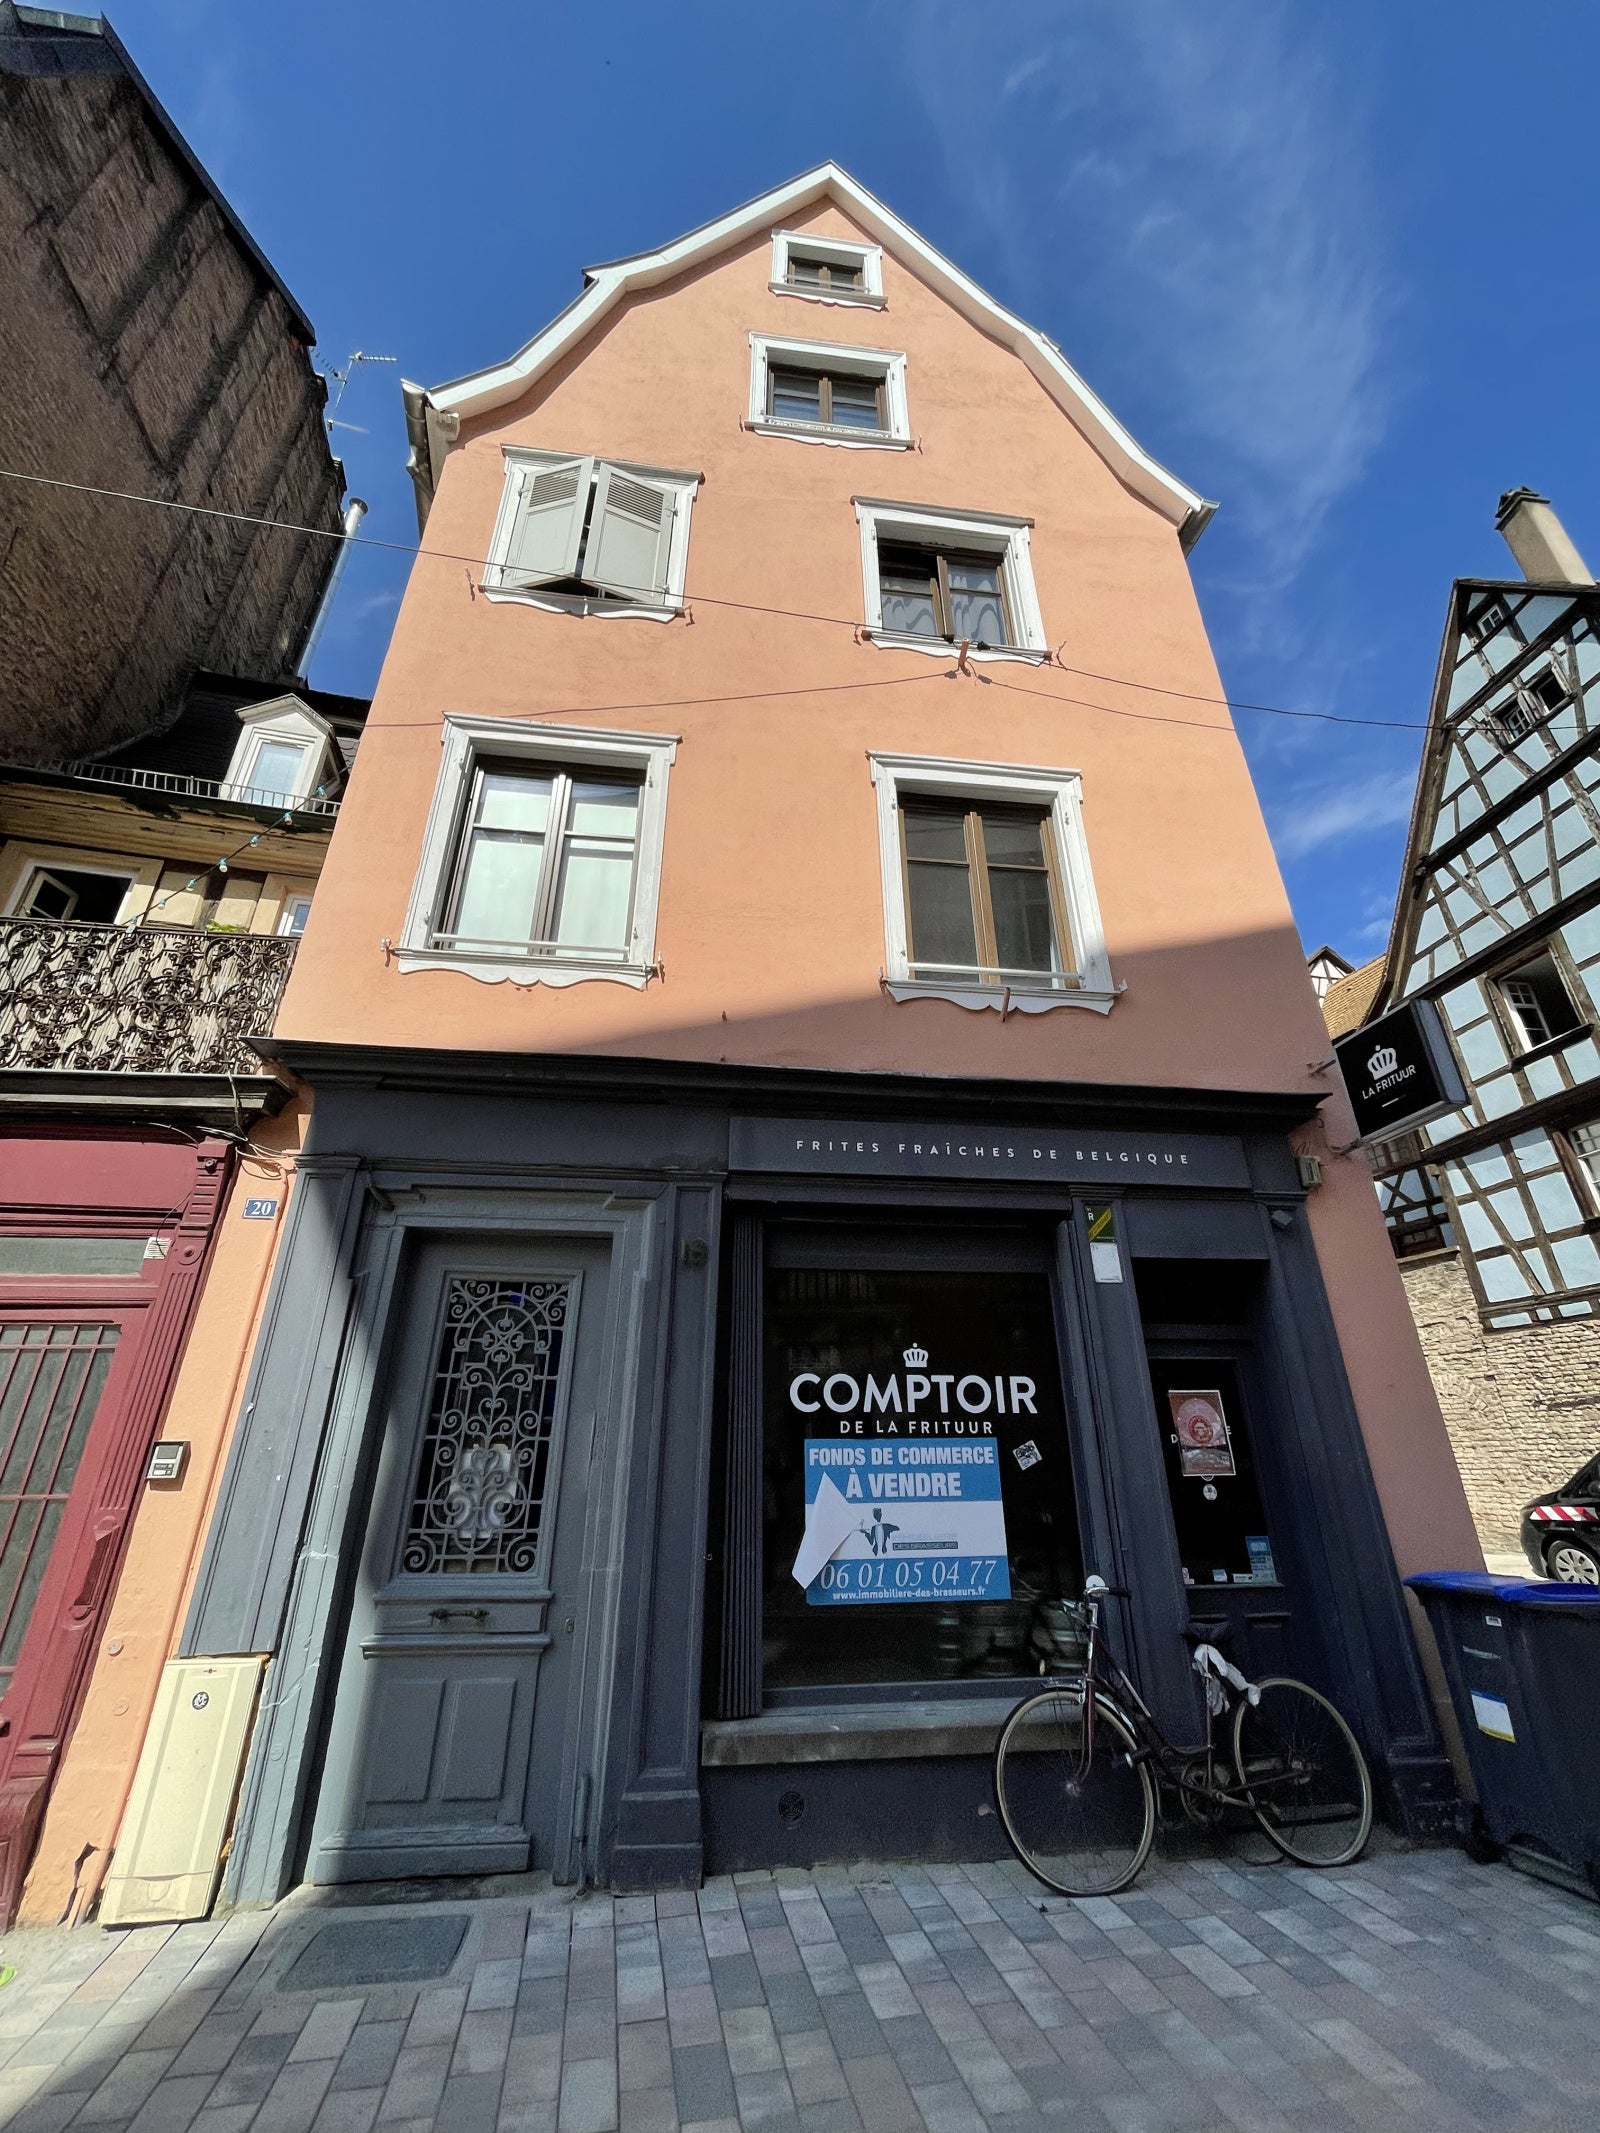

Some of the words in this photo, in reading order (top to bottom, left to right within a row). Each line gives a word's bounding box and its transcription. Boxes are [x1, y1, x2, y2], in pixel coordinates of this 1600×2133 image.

[1362, 1088, 1375, 1100] LA
[1375, 1064, 1417, 1093] FRITUUR
[796, 1140, 880, 1153] FRITES
[898, 1142, 1015, 1158] FRAÎCHES
[1033, 1149, 1057, 1160] DE
[1076, 1151, 1188, 1165] BELGIQUE
[251, 1201, 272, 1216] 20
[789, 1372, 1038, 1414] COMPTOIR
[840, 1420, 864, 1434] DE
[876, 1420, 899, 1434] LA
[908, 1420, 993, 1435] FRITUUR
[809, 1447, 866, 1467] FONDS
[871, 1447, 893, 1466] DE
[898, 1446, 995, 1465] COMMERCE
[846, 1467, 863, 1499] À
[868, 1472, 962, 1498] VENDRE
[820, 1563, 851, 1590] 06
[858, 1562, 885, 1588] 01
[895, 1561, 924, 1587] 05
[932, 1560, 960, 1587] 04
[970, 1560, 997, 1585] 77
